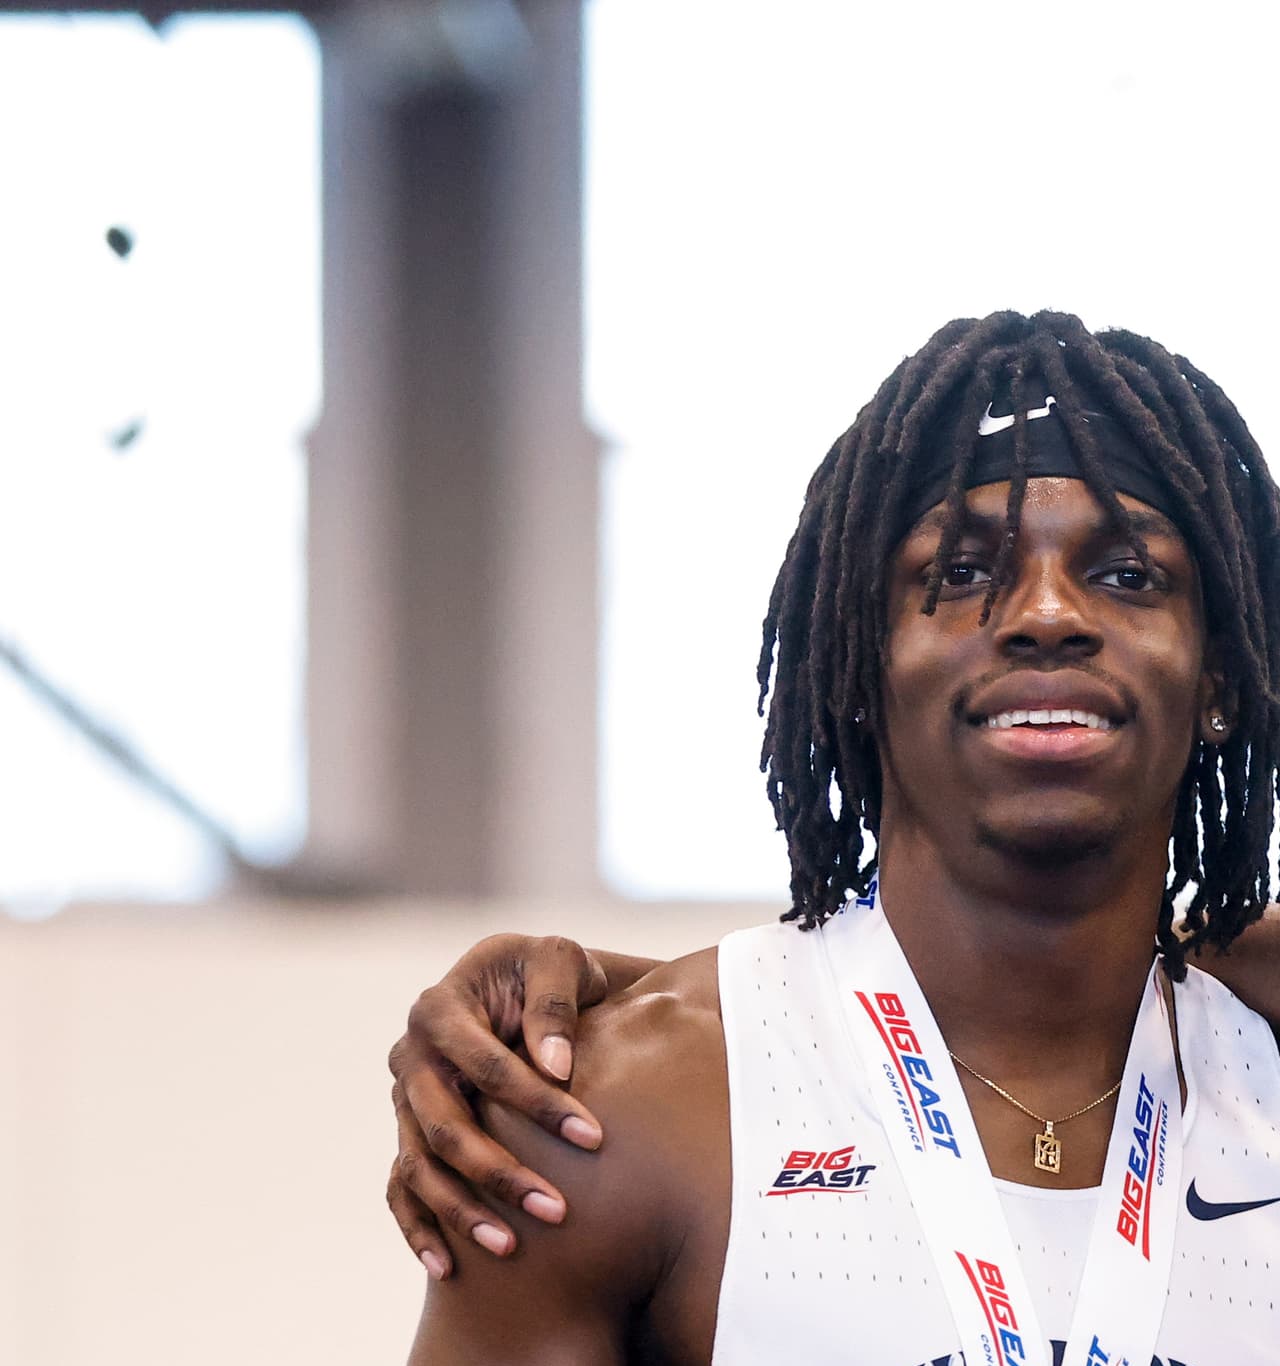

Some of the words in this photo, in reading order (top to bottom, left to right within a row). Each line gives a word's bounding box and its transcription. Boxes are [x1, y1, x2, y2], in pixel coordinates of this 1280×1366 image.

[883, 1063, 922, 1152] CONFERENCE
[784, 1146, 856, 1169] BIG
[1157, 1101, 1168, 1185] CONFERENCE
[773, 1165, 876, 1187] EAST
